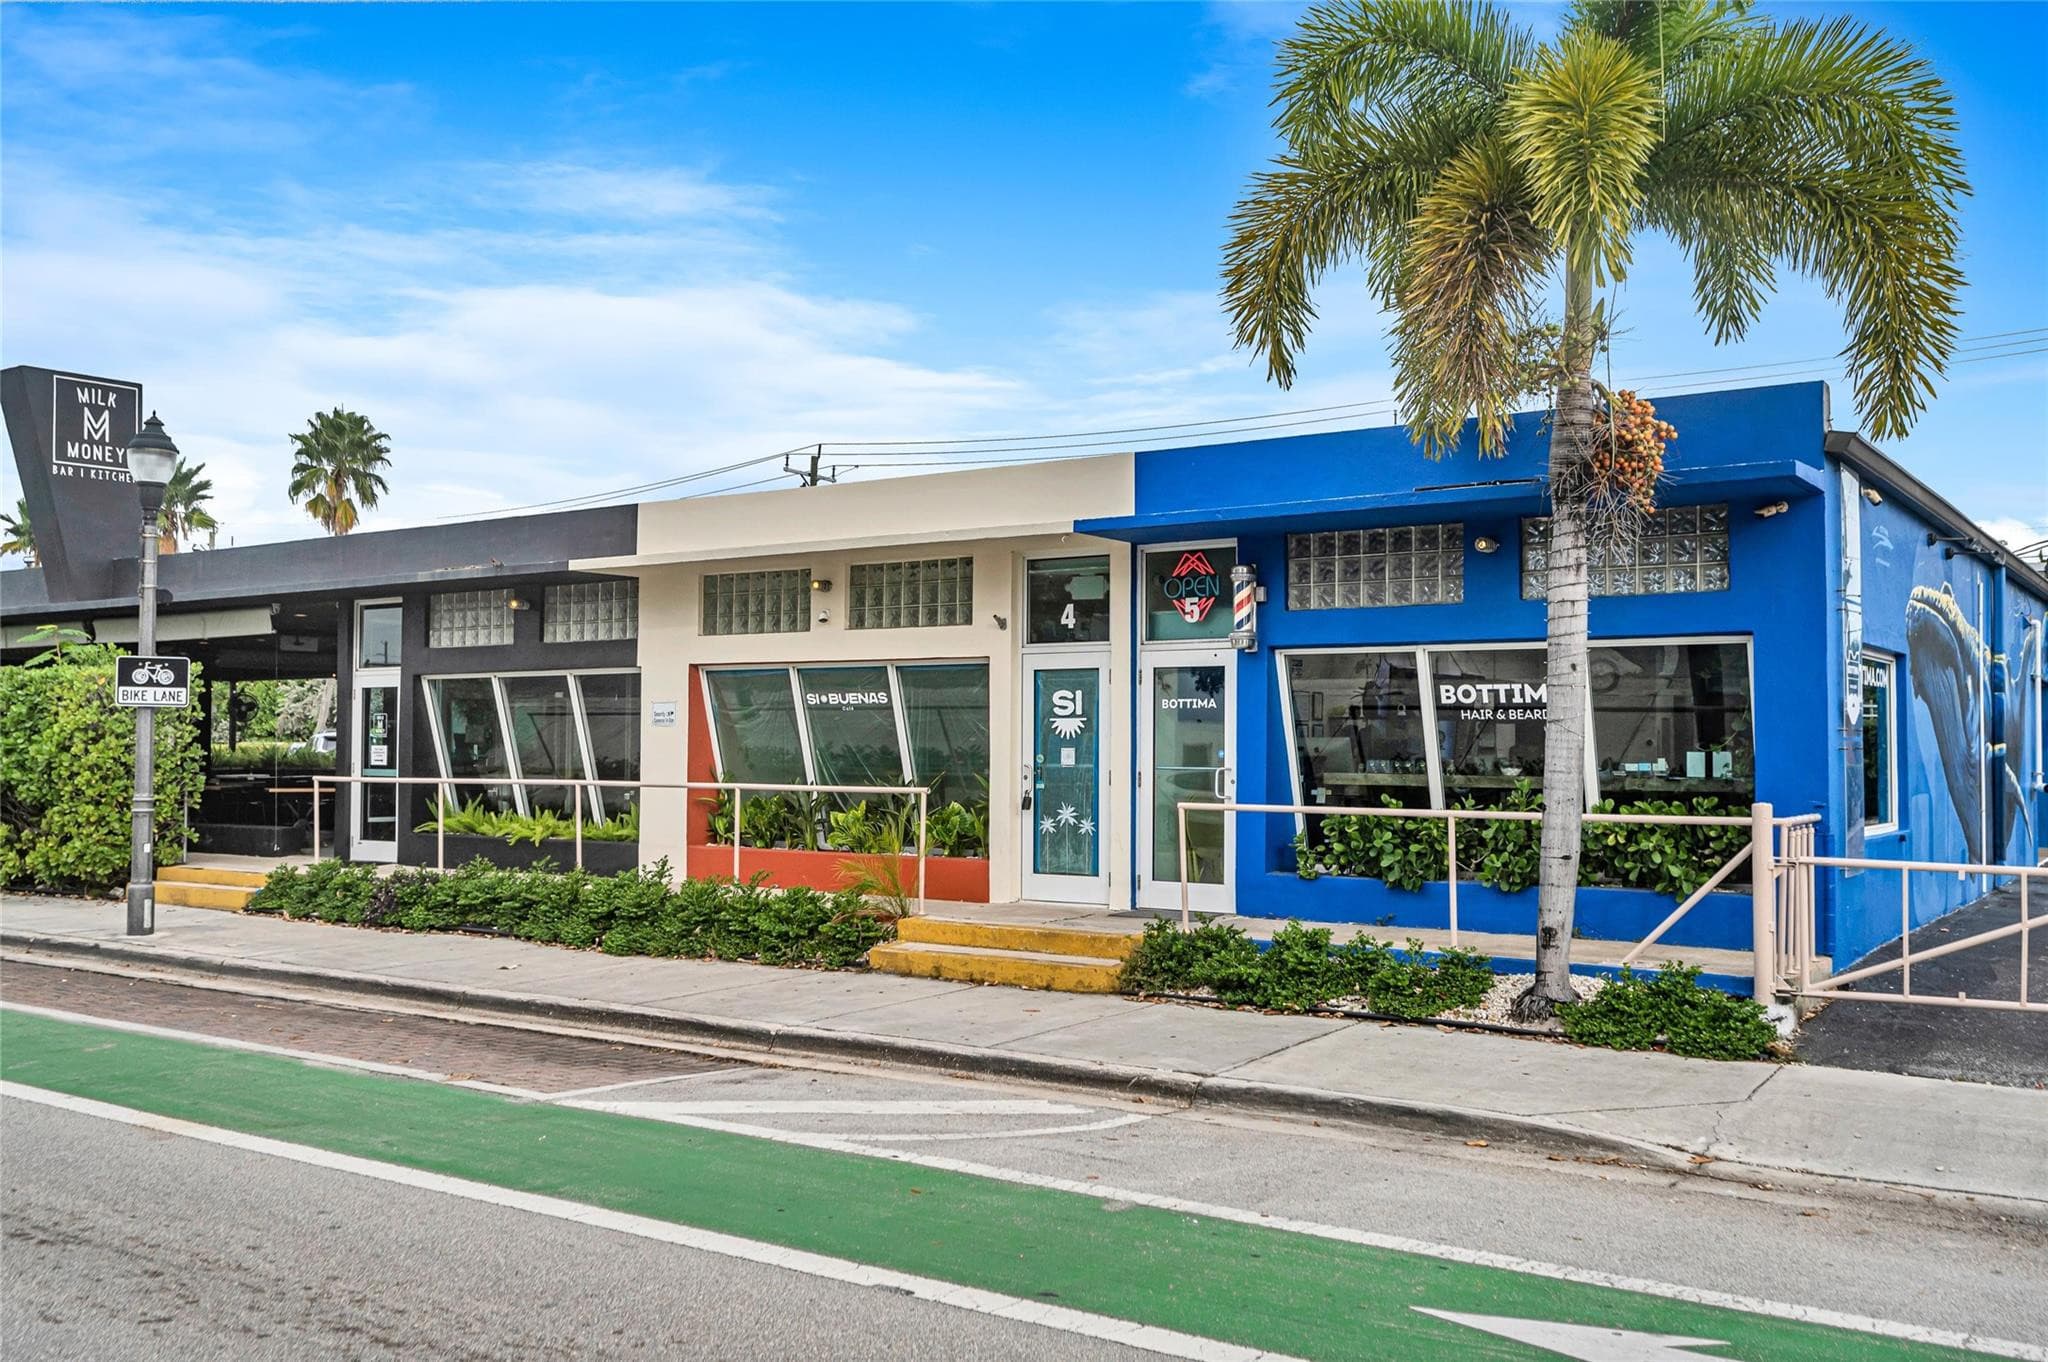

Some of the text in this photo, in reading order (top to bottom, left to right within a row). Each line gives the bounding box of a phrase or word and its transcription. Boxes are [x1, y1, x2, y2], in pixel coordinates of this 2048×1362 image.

[77, 387, 116, 408] MILK
[67, 441, 125, 463] MONEY
[52, 465, 74, 477] BAR
[90, 469, 136, 483] KITCHE
[1164, 576, 1219, 598] OPEN
[1061, 603, 1076, 629] 4
[1184, 597, 1200, 623] 5
[122, 690, 183, 702] BIKE LANE
[1052, 690, 1083, 716] SI
[1161, 698, 1217, 709] BOTTIMA
[1440, 683, 1548, 704] BOTTIM
[1461, 709, 1494, 720] HAIR
[1496, 709, 1506, 720] &
